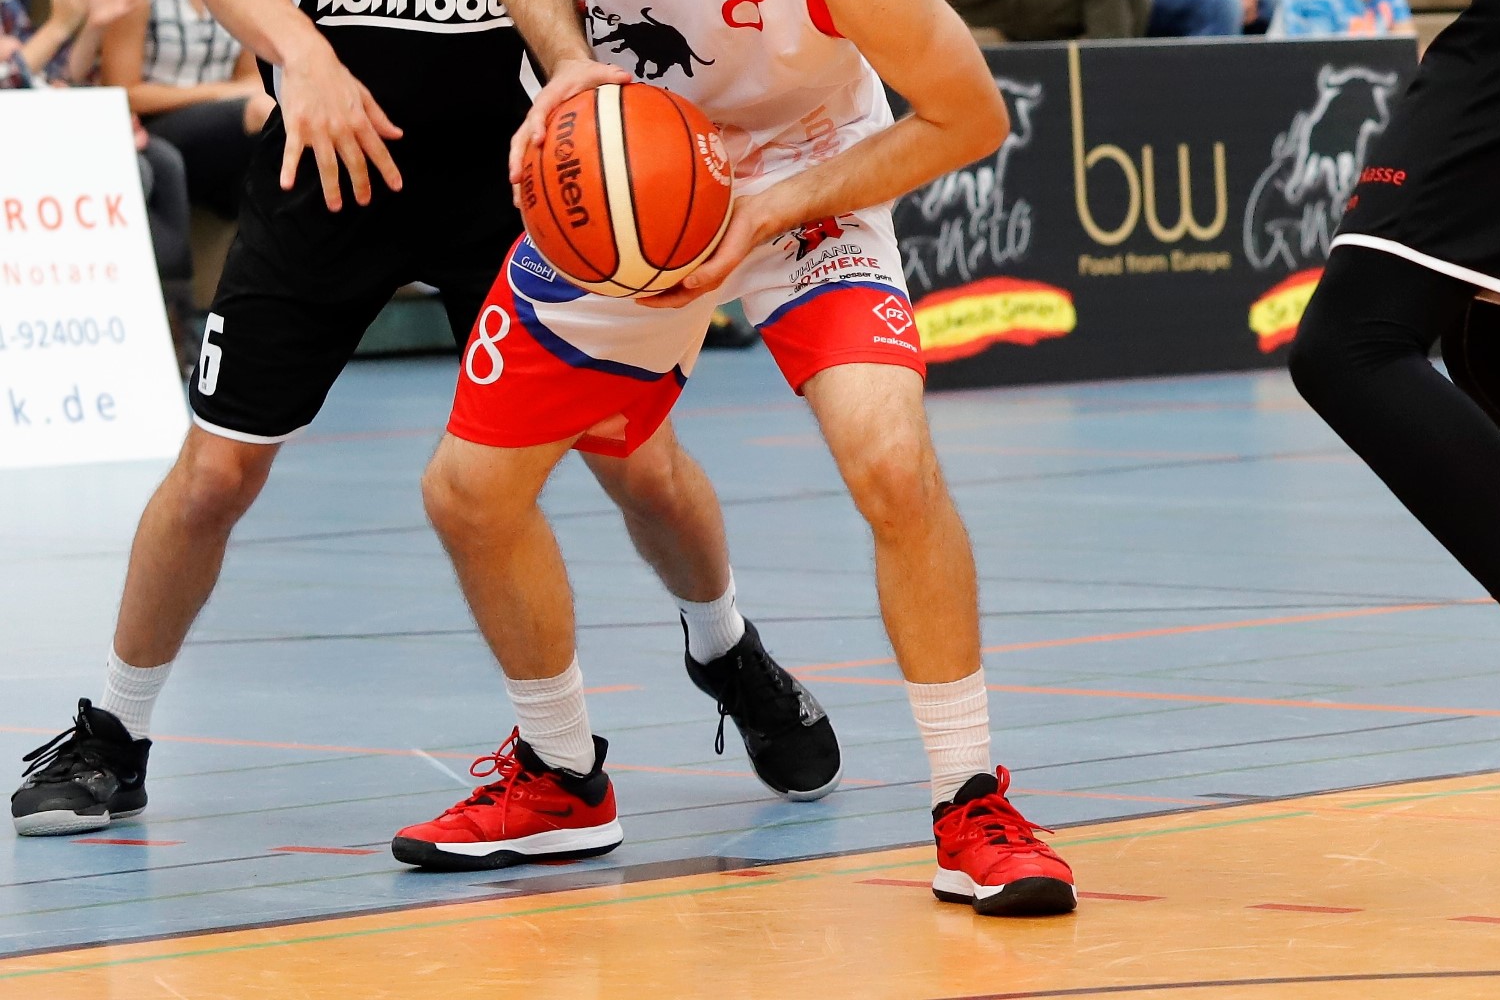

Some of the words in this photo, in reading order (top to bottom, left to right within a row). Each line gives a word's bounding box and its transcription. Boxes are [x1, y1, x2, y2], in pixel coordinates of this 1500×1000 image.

[554, 111, 590, 229] molten
[1068, 40, 1228, 247] bw
[521, 256, 552, 277] GmbH
[788, 244, 862, 284] UHLAND
[198, 311, 225, 396] 6
[466, 304, 511, 385] 8
[873, 335, 918, 353] peakzone
